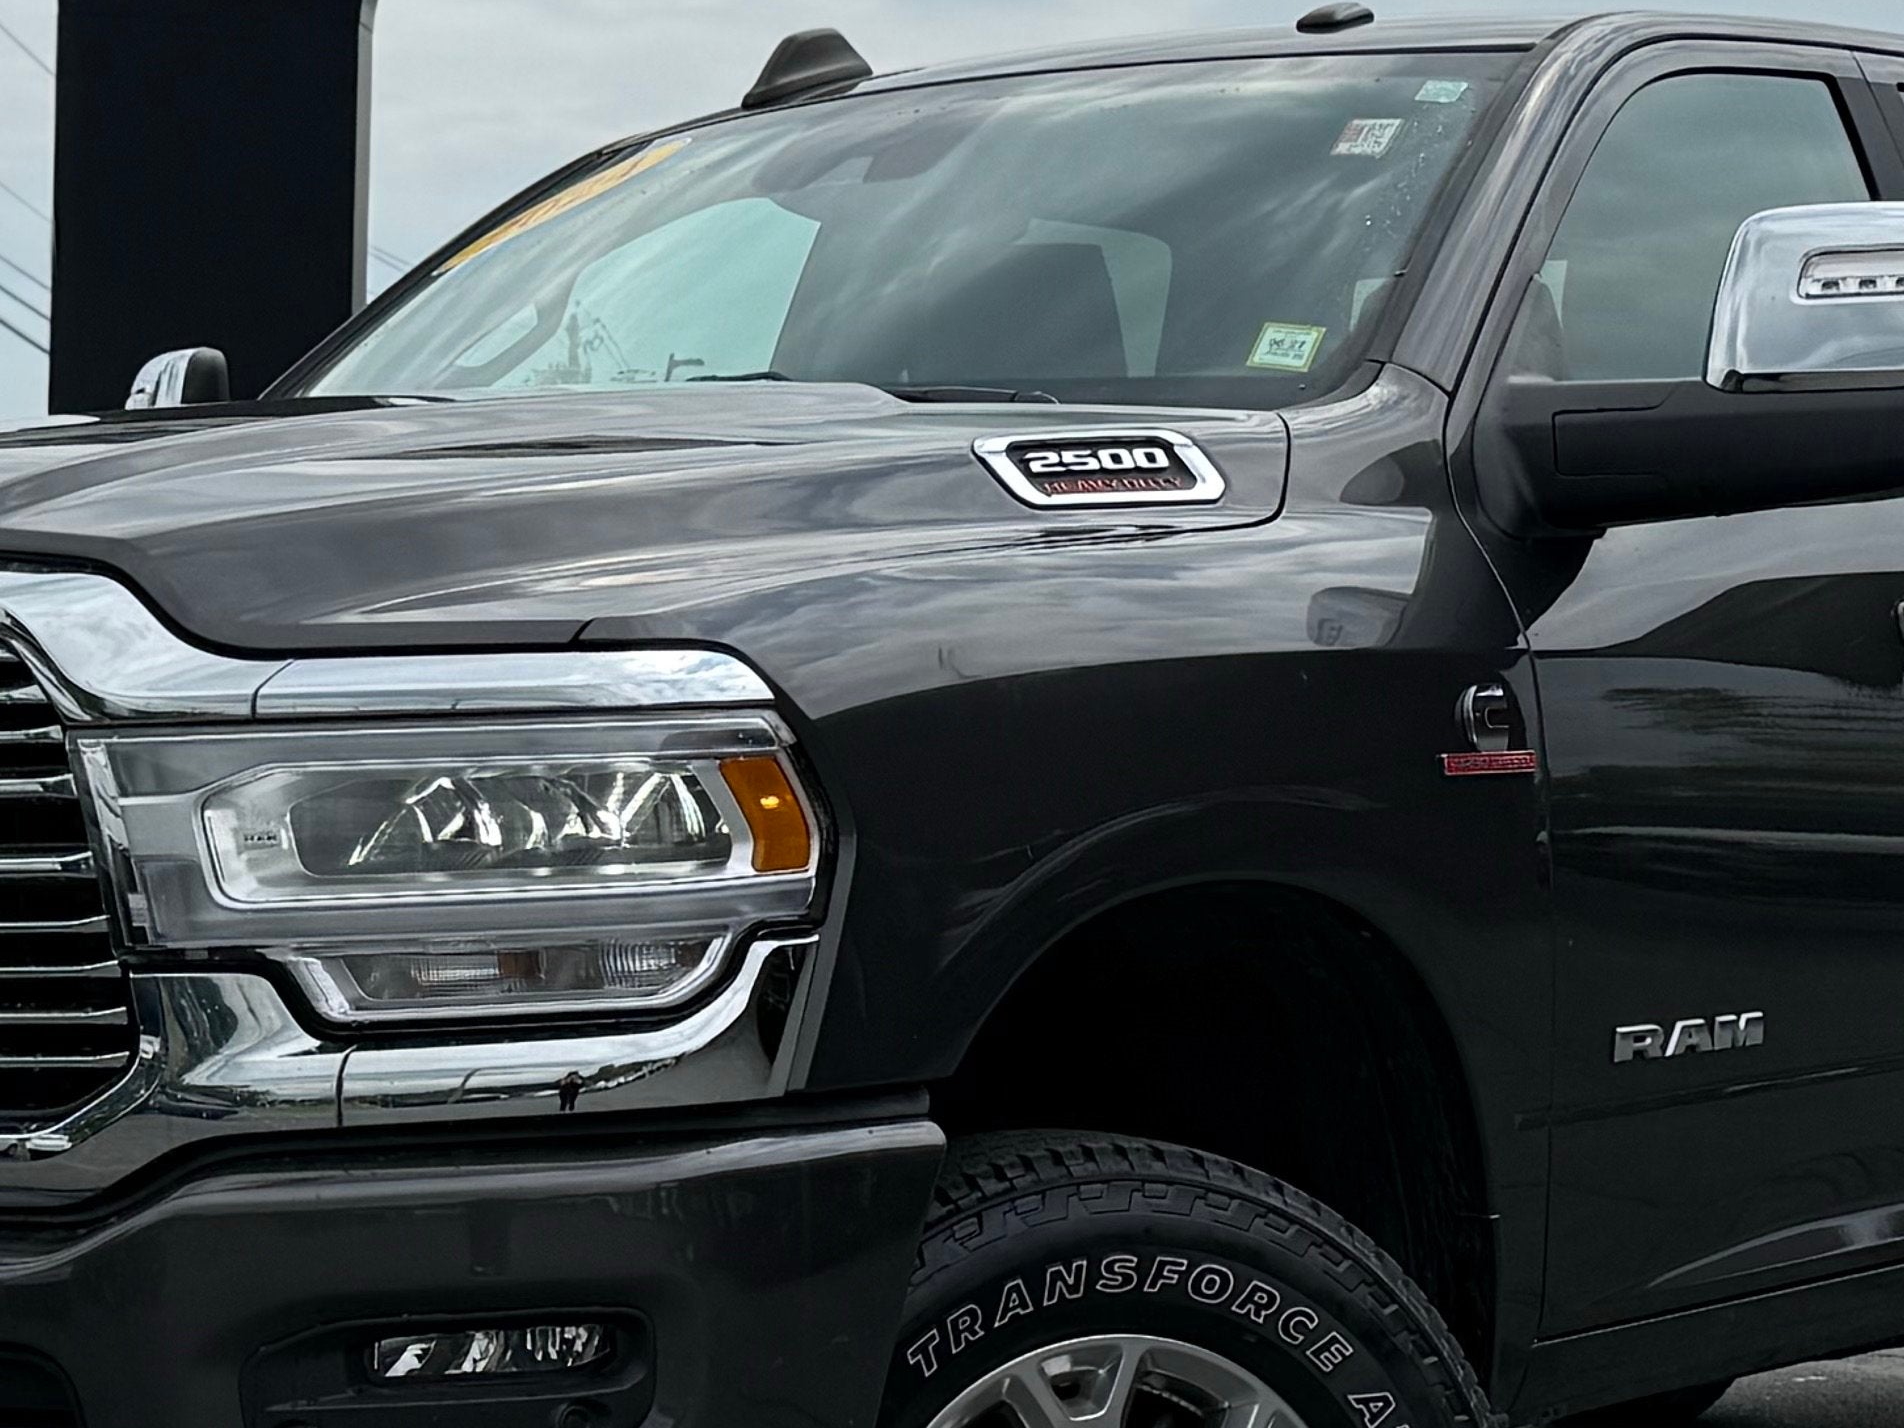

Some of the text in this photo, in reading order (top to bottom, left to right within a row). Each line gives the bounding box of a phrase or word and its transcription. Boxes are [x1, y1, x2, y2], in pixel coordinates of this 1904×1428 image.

[1022, 447, 1170, 474] 2500
[1613, 1011, 1764, 1063] RAM
[907, 1253, 1352, 1378] TRANSFORCE
